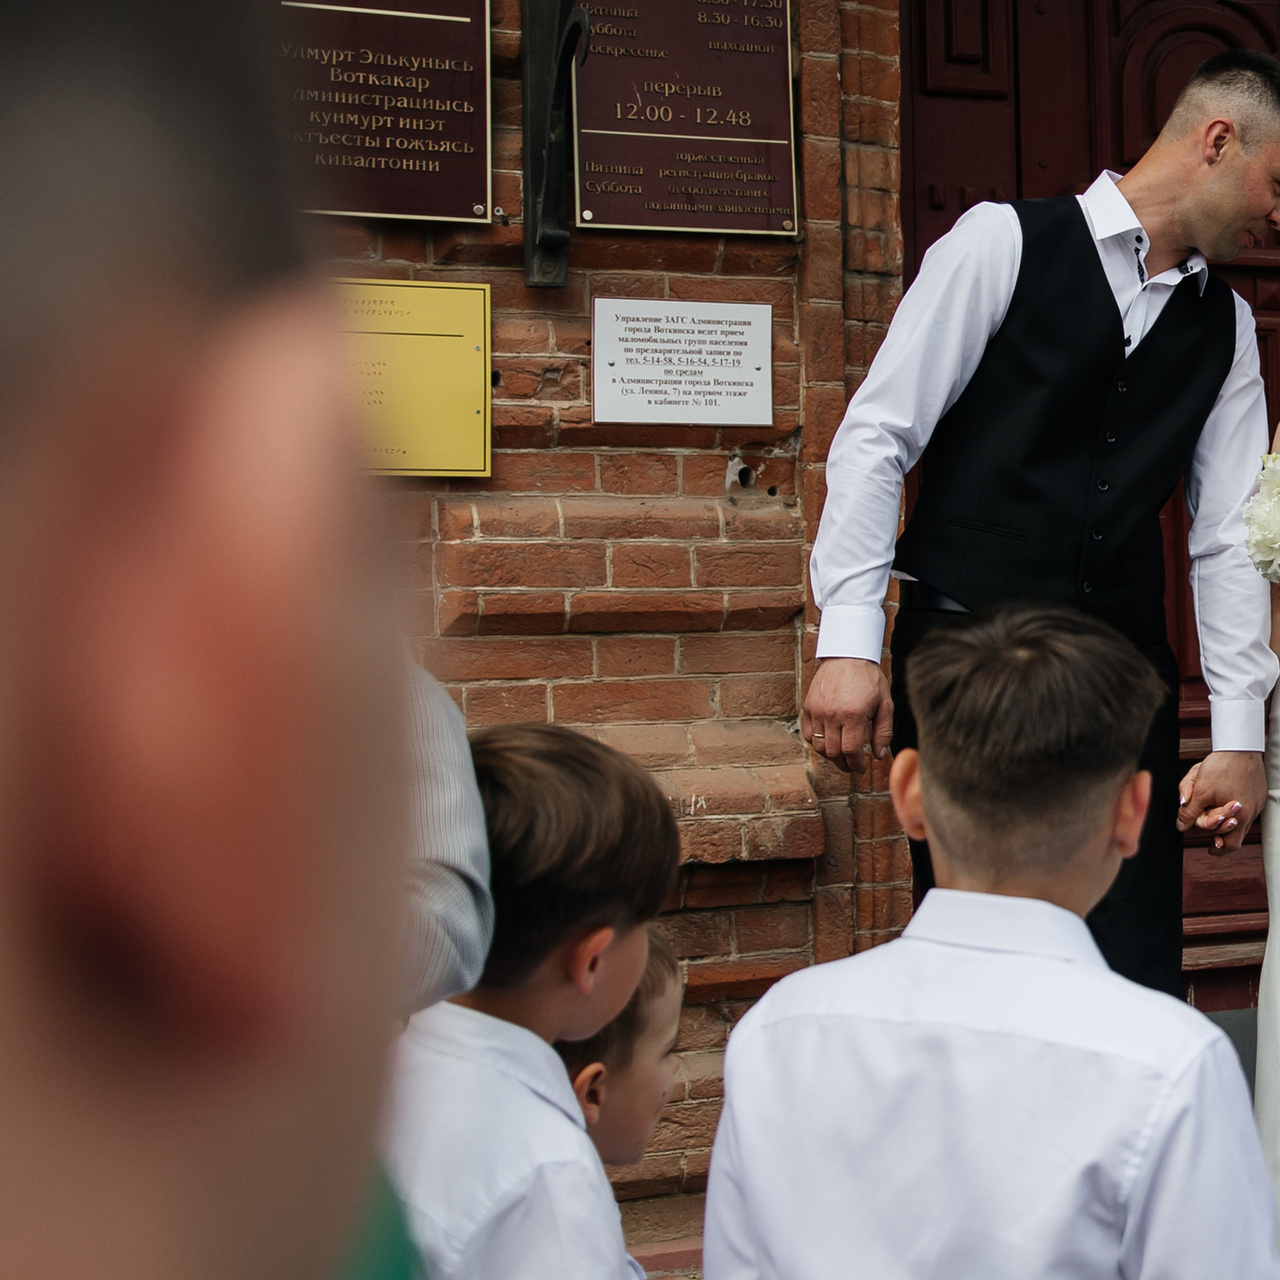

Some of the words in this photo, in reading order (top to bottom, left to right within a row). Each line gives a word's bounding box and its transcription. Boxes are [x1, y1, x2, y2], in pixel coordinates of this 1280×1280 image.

[697, 11, 731, 25] 8.30
[744, 14, 784, 29] 16.30
[589, 22, 637, 38] уббота
[280, 43, 355, 64] Удмурт
[359, 49, 474, 72] Элькунысь
[588, 44, 669, 60] оскресенье
[330, 68, 430, 92] Воткакар
[644, 81, 722, 98] перерыв
[310, 111, 394, 131] кунмурт
[399, 117, 446, 131] инэт
[615, 102, 673, 122] 12.00
[695, 108, 752, 126] 12.48
[287, 131, 380, 148] ктъесты
[386, 136, 474, 154] гожъясь
[315, 153, 440, 172] кивалтонни
[674, 151, 764, 165] торжественная
[585, 161, 644, 176] Пятница
[658, 167, 733, 180] регистрация
[735, 169, 778, 183] браков
[585, 180, 643, 195] Суббота
[614, 313, 662, 325] Управление
[664, 316, 688, 325] ЗАГС
[689, 317, 752, 328] Администрации
[624, 326, 651, 335] города
[654, 326, 696, 335] Воткинска
[697, 328, 718, 336] ведет
[720, 330, 744, 338] прием
[618, 336, 682, 345] маломобильных
[684, 338, 707, 347] групп
[709, 339, 748, 347] населения
[635, 347, 703, 356] предварительной
[705, 349, 731, 357] записи
[626, 357, 640, 365] тел.
[643, 357, 676, 367] 5-14-58,
[677, 358, 709, 367] 5-16-54,
[711, 358, 741, 367] 5-17-19
[675, 369, 704, 378] средам
[619, 377, 683, 388] Администрации
[684, 380, 711, 389] города
[713, 379, 754, 388] Воткинска
[621, 387, 636, 396] (ул.
[637, 387, 671, 396] Ленина,
[672, 388, 681, 397] 7)
[694, 390, 723, 398] первом
[654, 398, 690, 406] кабинете
